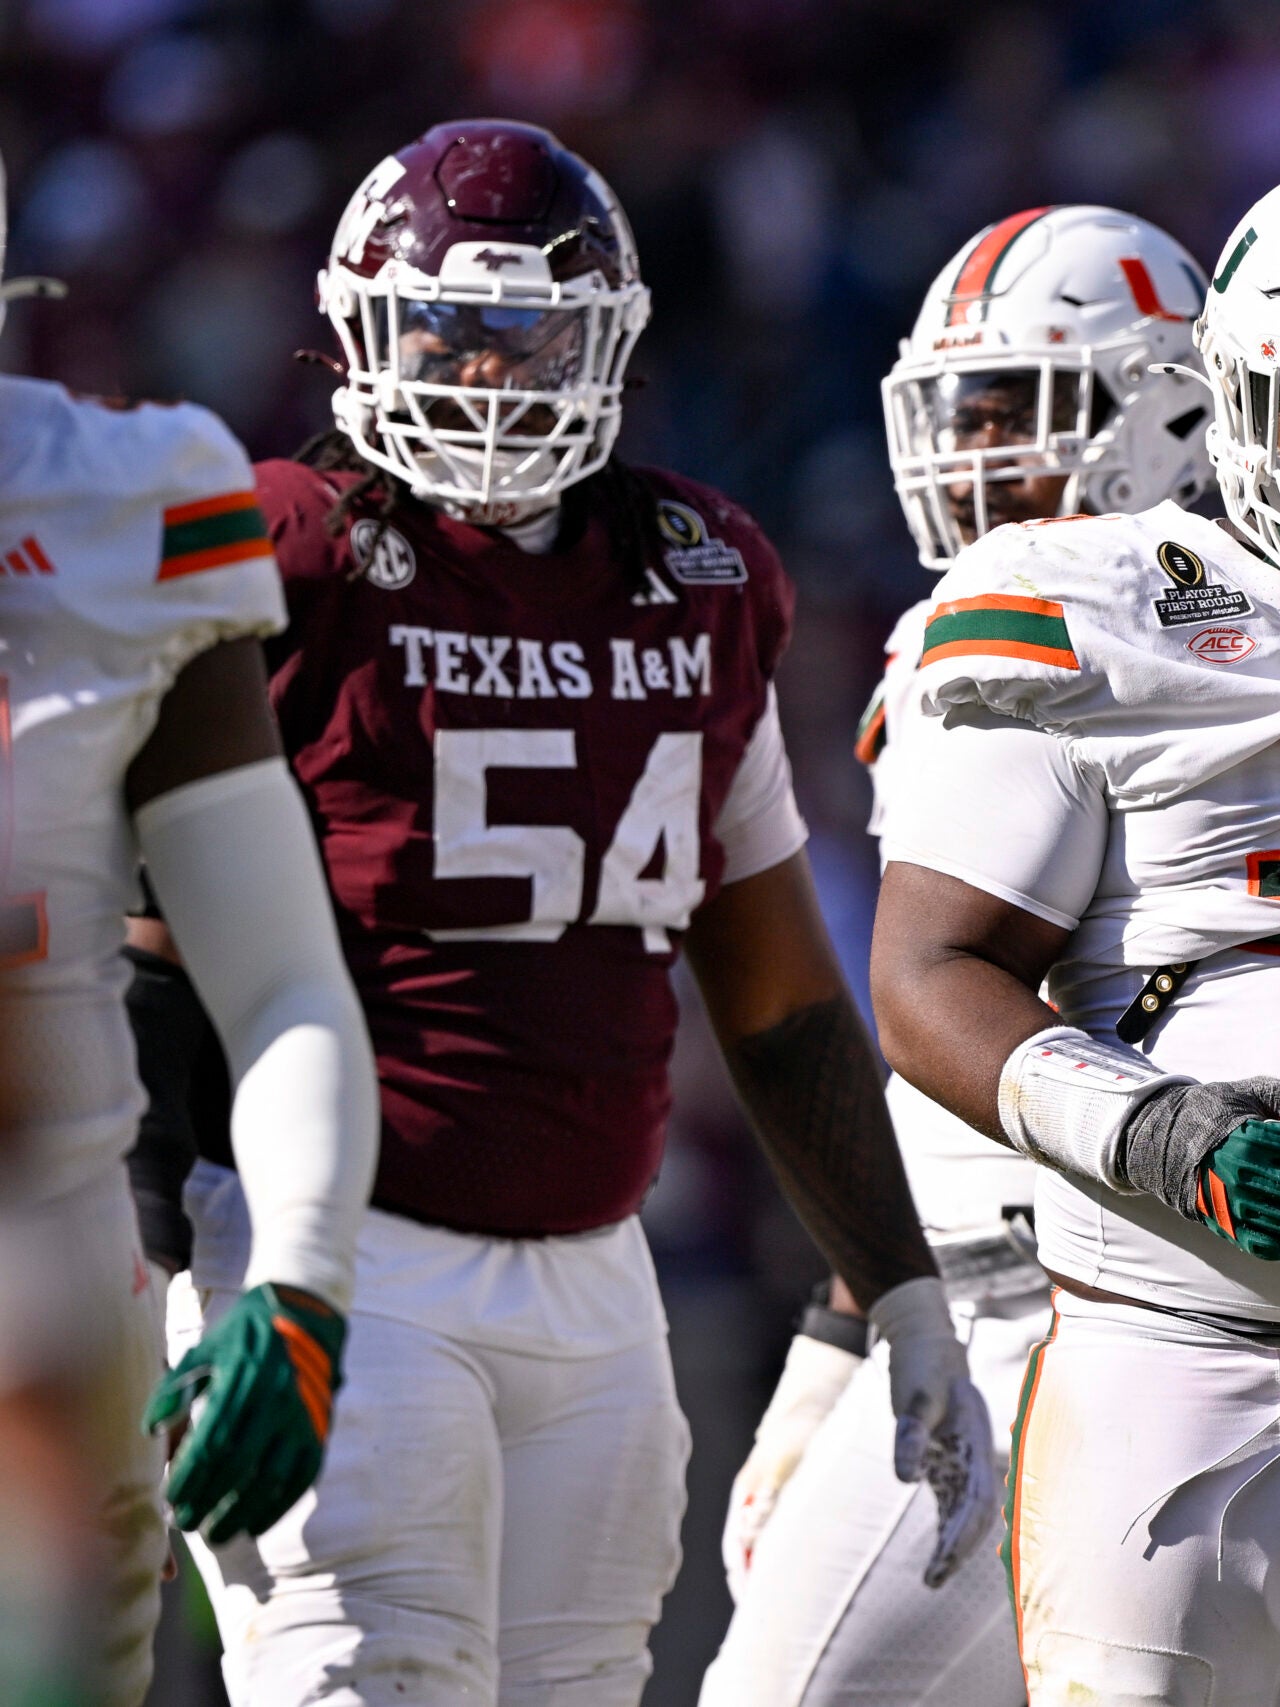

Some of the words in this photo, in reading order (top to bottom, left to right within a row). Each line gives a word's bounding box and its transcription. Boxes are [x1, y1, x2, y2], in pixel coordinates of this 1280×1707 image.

[1159, 600, 1195, 613] FIRST
[1197, 594, 1243, 609] ROUND
[1168, 588, 1222, 600] PLAYOFF
[1198, 636, 1245, 650] ACC
[388, 624, 593, 699] TEXAS
[610, 633, 711, 700] A&M
[421, 729, 706, 953] 54
